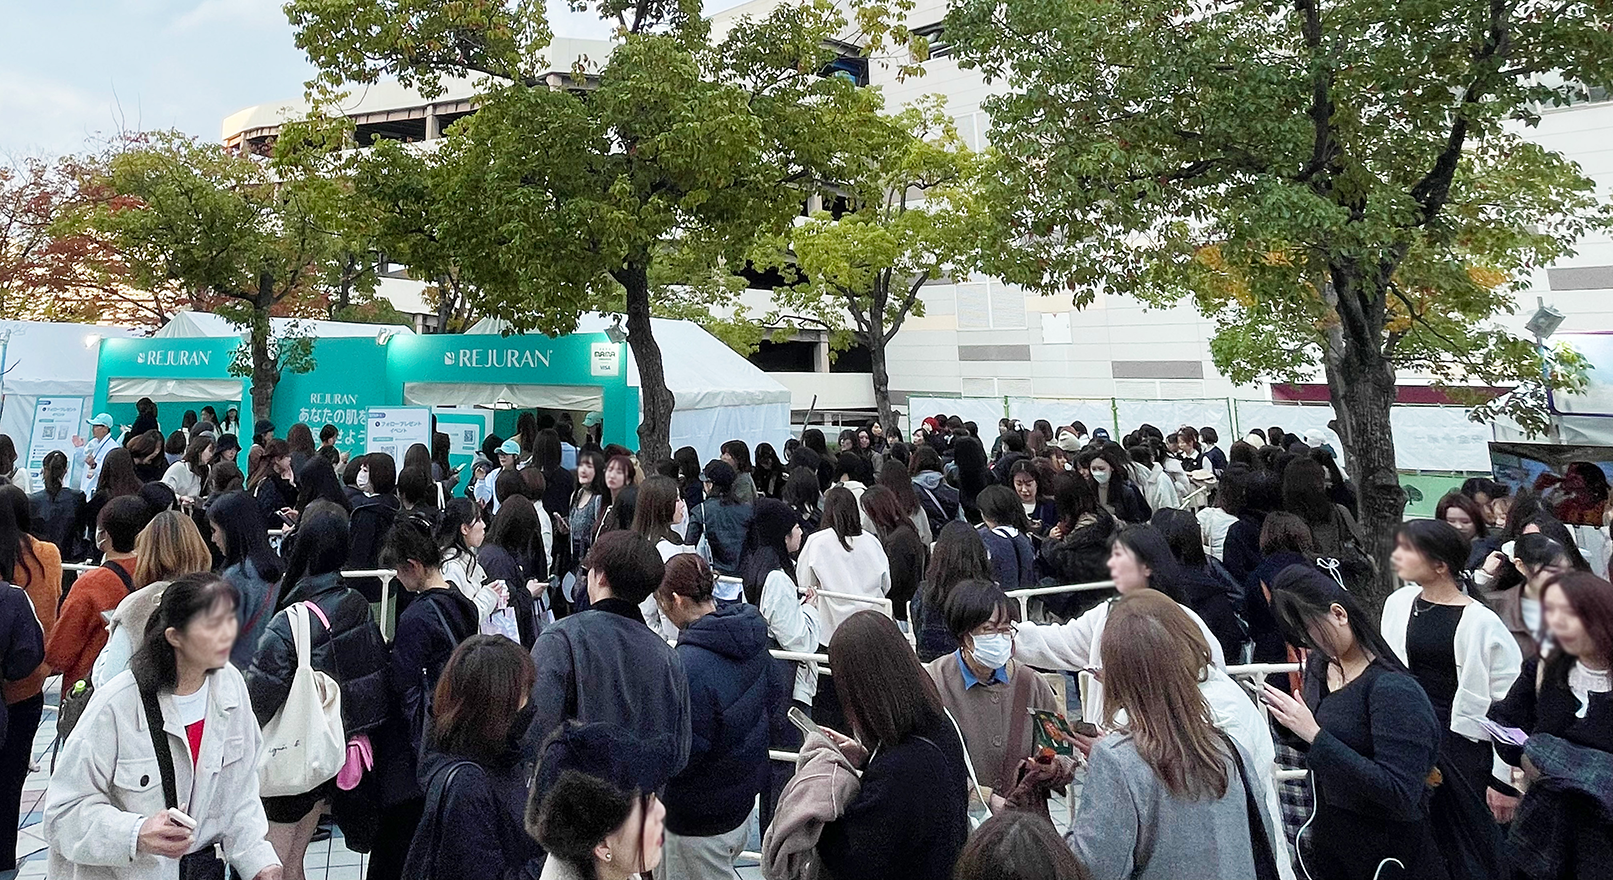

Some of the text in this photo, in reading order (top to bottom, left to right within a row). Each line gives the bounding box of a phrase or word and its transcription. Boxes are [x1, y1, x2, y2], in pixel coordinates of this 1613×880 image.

[147, 350, 210, 366] REJURAN
[459, 349, 550, 368] REJURAN
[310, 392, 357, 405] REJURAN
[298, 407, 366, 425] あなたの肌を
